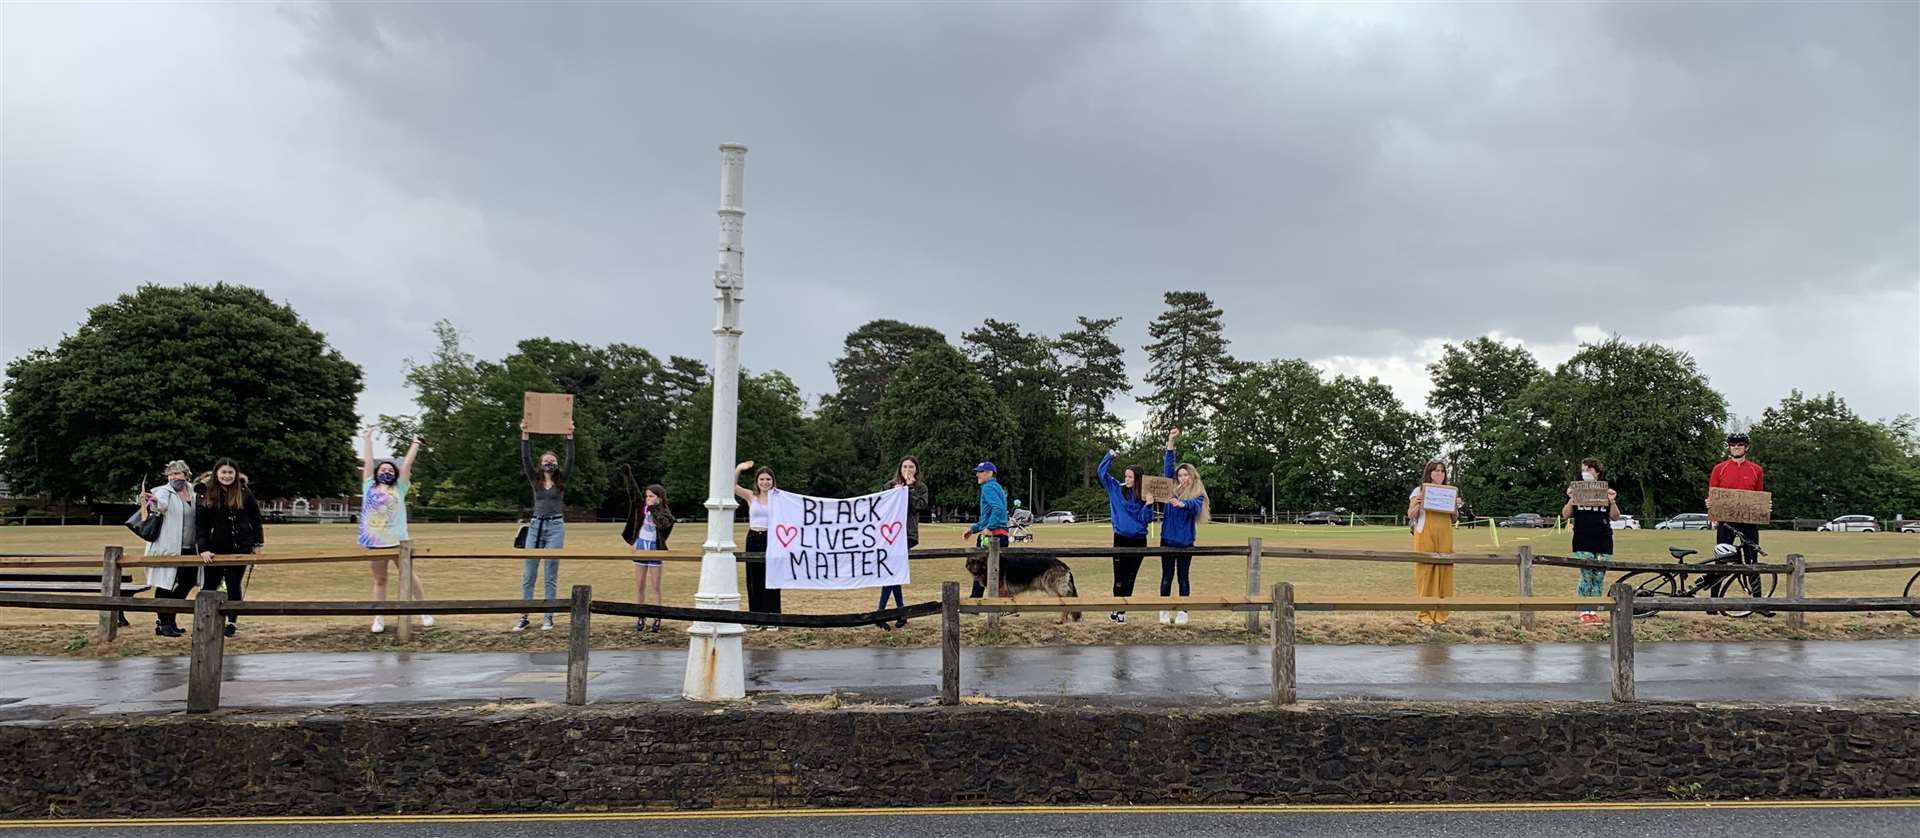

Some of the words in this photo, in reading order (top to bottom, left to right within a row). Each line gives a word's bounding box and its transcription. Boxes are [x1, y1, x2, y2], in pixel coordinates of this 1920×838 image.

[802, 496, 881, 526] BLACK
[800, 524, 876, 550] LIVES
[789, 548, 893, 580] MATTER
